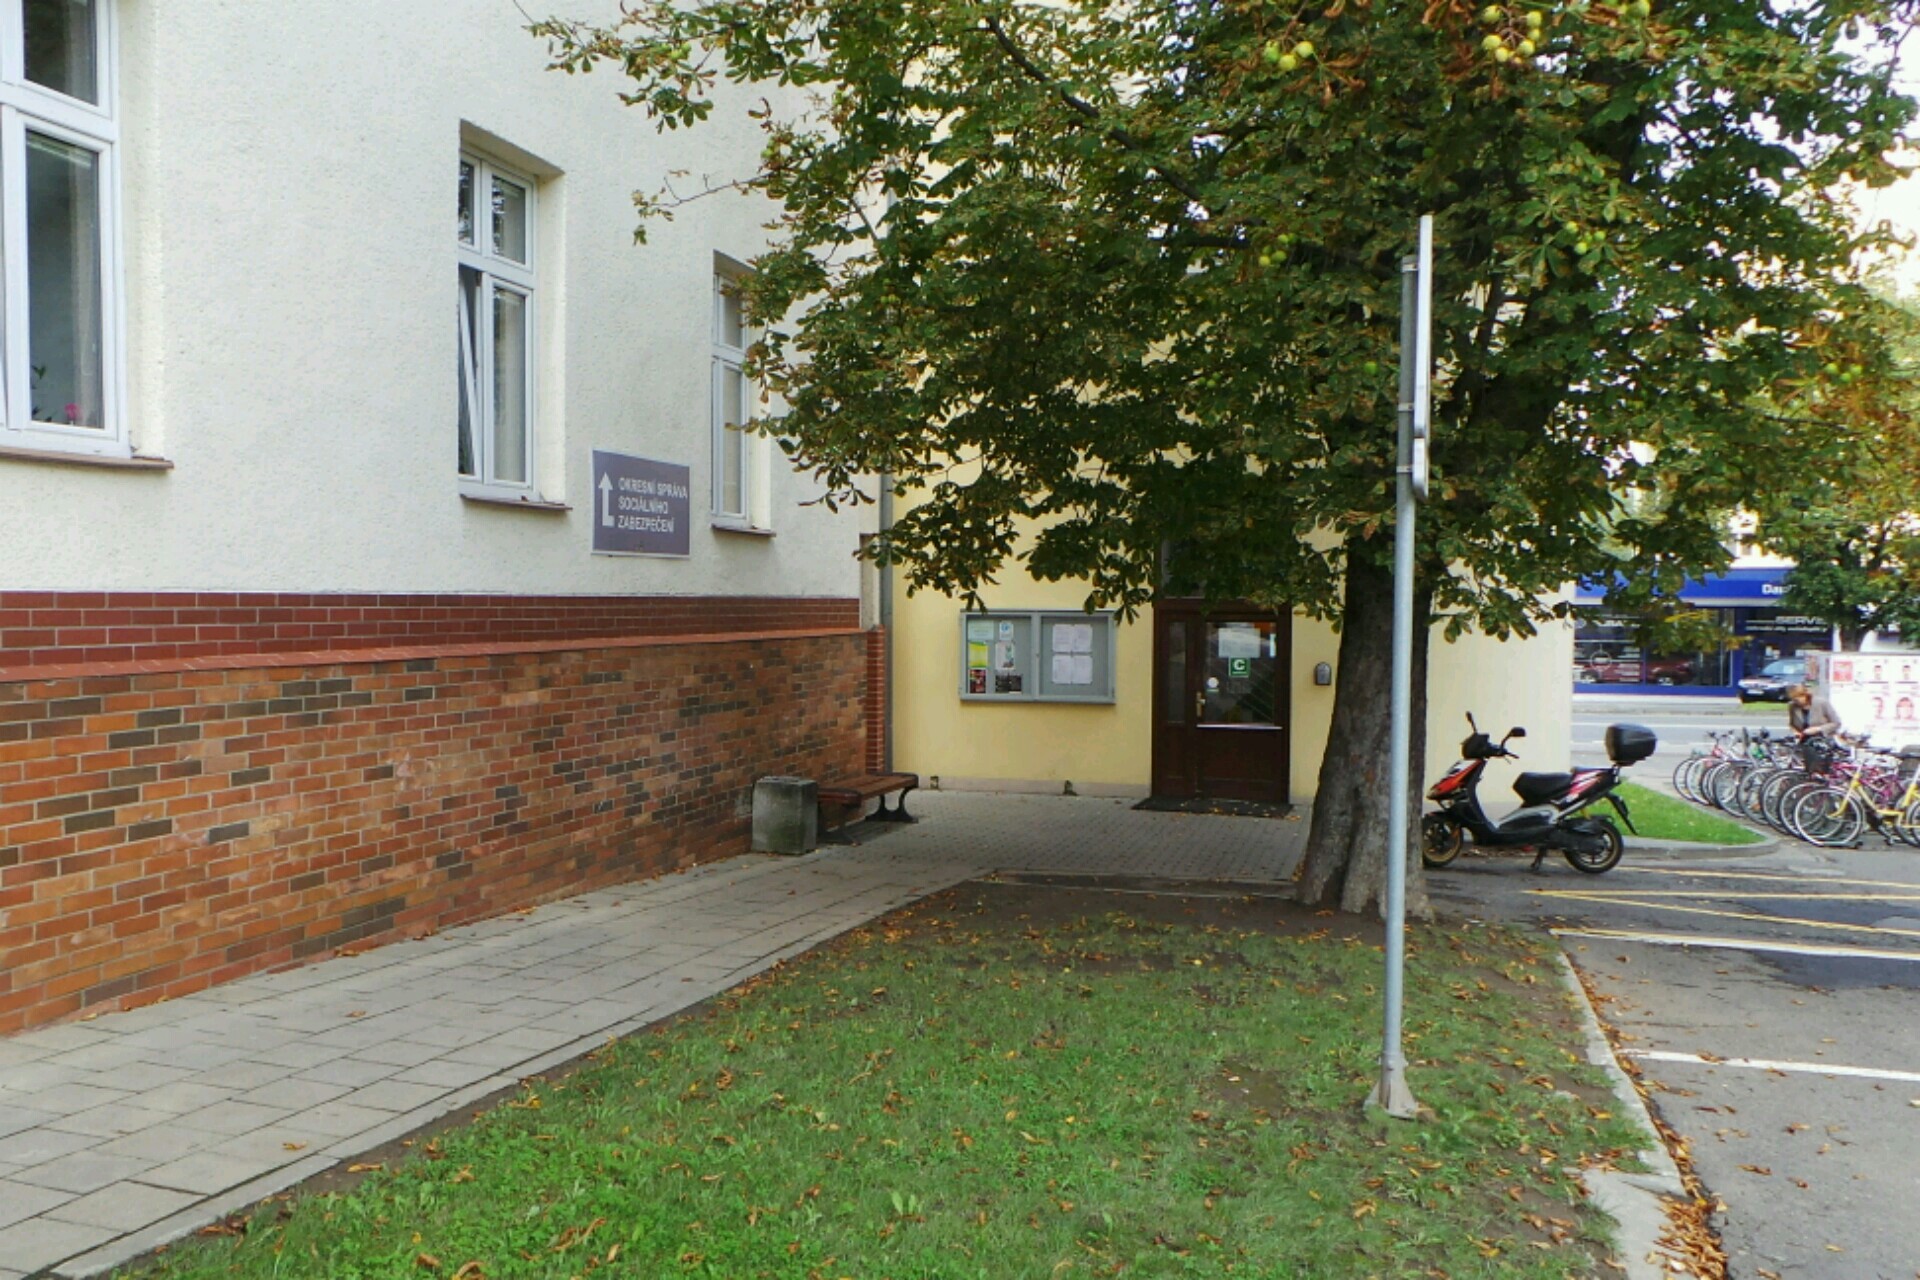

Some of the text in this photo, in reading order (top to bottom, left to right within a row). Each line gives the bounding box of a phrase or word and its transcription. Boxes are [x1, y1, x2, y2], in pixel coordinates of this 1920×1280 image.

[618, 477, 688, 499] OKRESNÍ SPRÁVA
[618, 495, 668, 514] SOCIÁLNÍHO
[618, 515, 674, 532] ZABEZPEČENÍ
